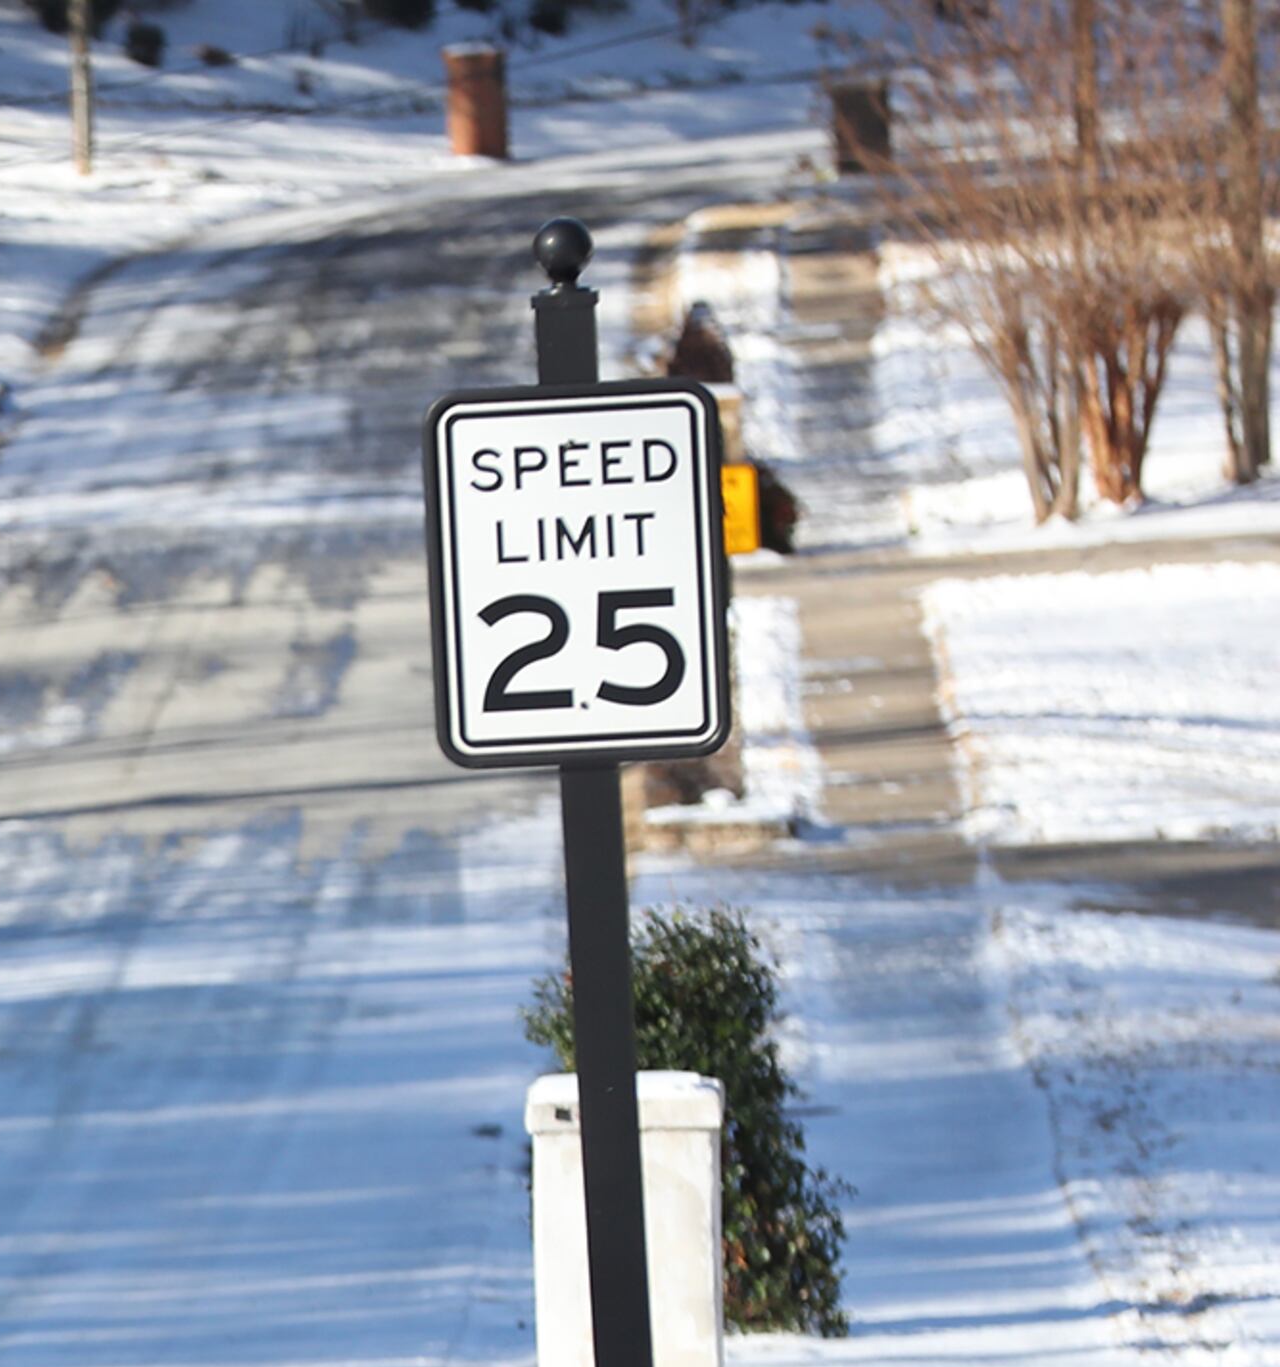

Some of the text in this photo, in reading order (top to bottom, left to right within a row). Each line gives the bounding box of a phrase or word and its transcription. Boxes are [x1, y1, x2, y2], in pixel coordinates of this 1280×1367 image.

[470, 438, 679, 492] SPEED
[495, 512, 656, 564] LIMIT
[476, 587, 686, 713] 25
